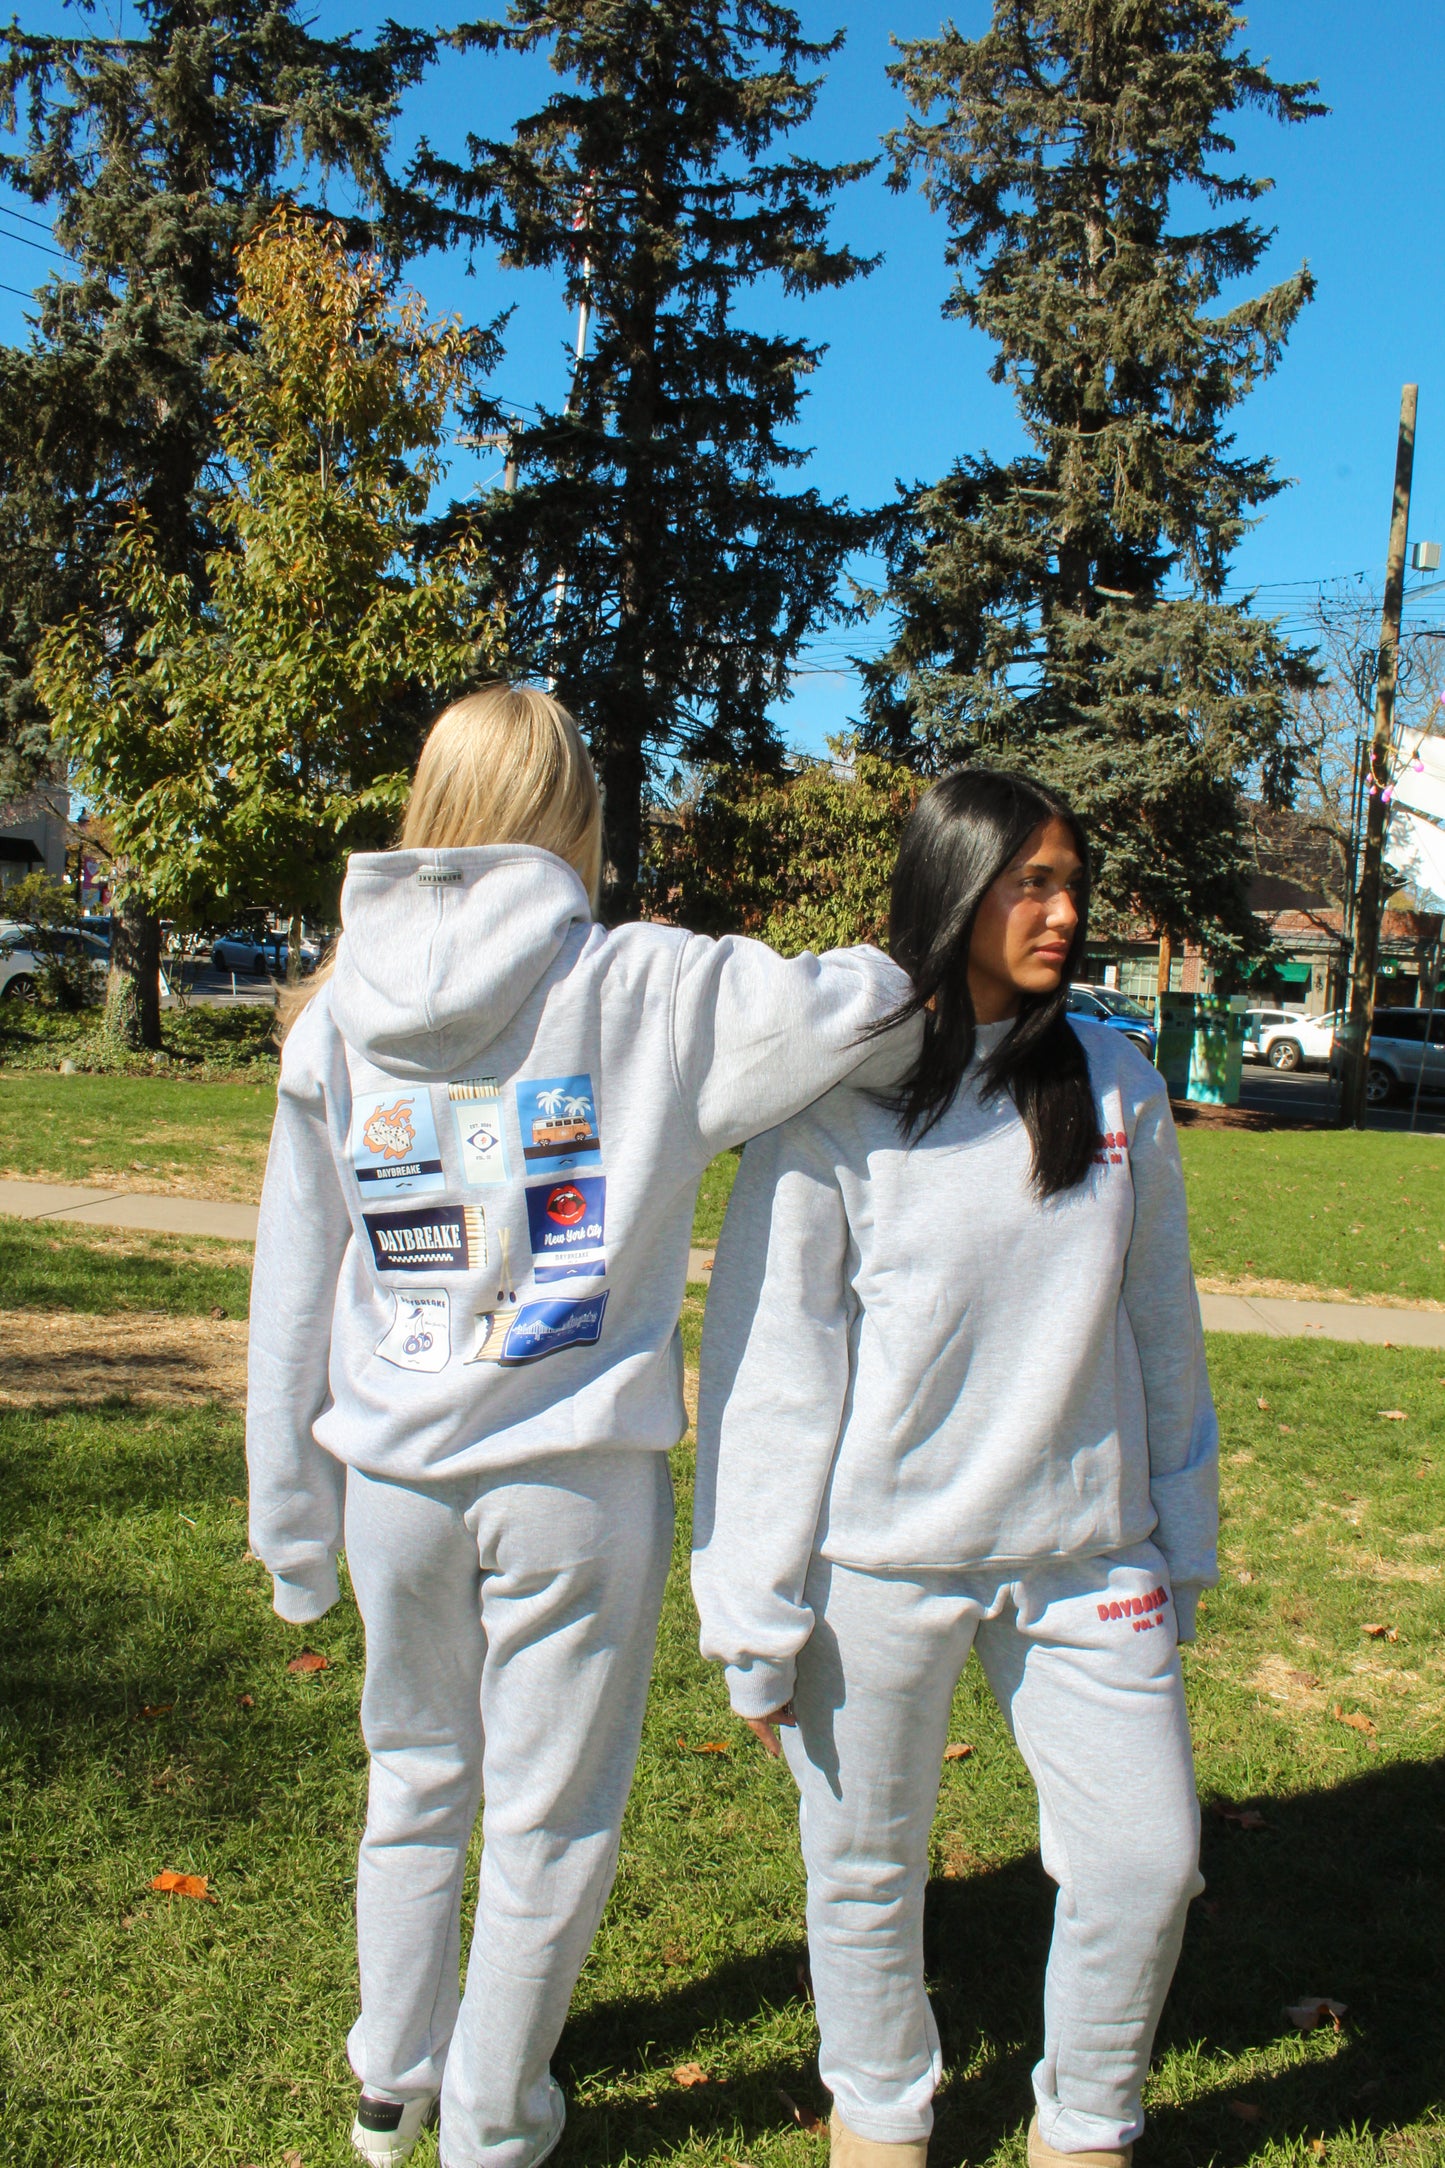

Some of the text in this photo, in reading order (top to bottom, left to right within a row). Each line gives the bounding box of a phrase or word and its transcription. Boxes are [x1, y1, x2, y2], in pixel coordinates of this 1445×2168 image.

[376, 1164, 421, 1178] DAYBREAKE
[376, 1224, 461, 1251] DAYBREAKE
[544, 1223, 603, 1246] New York City
